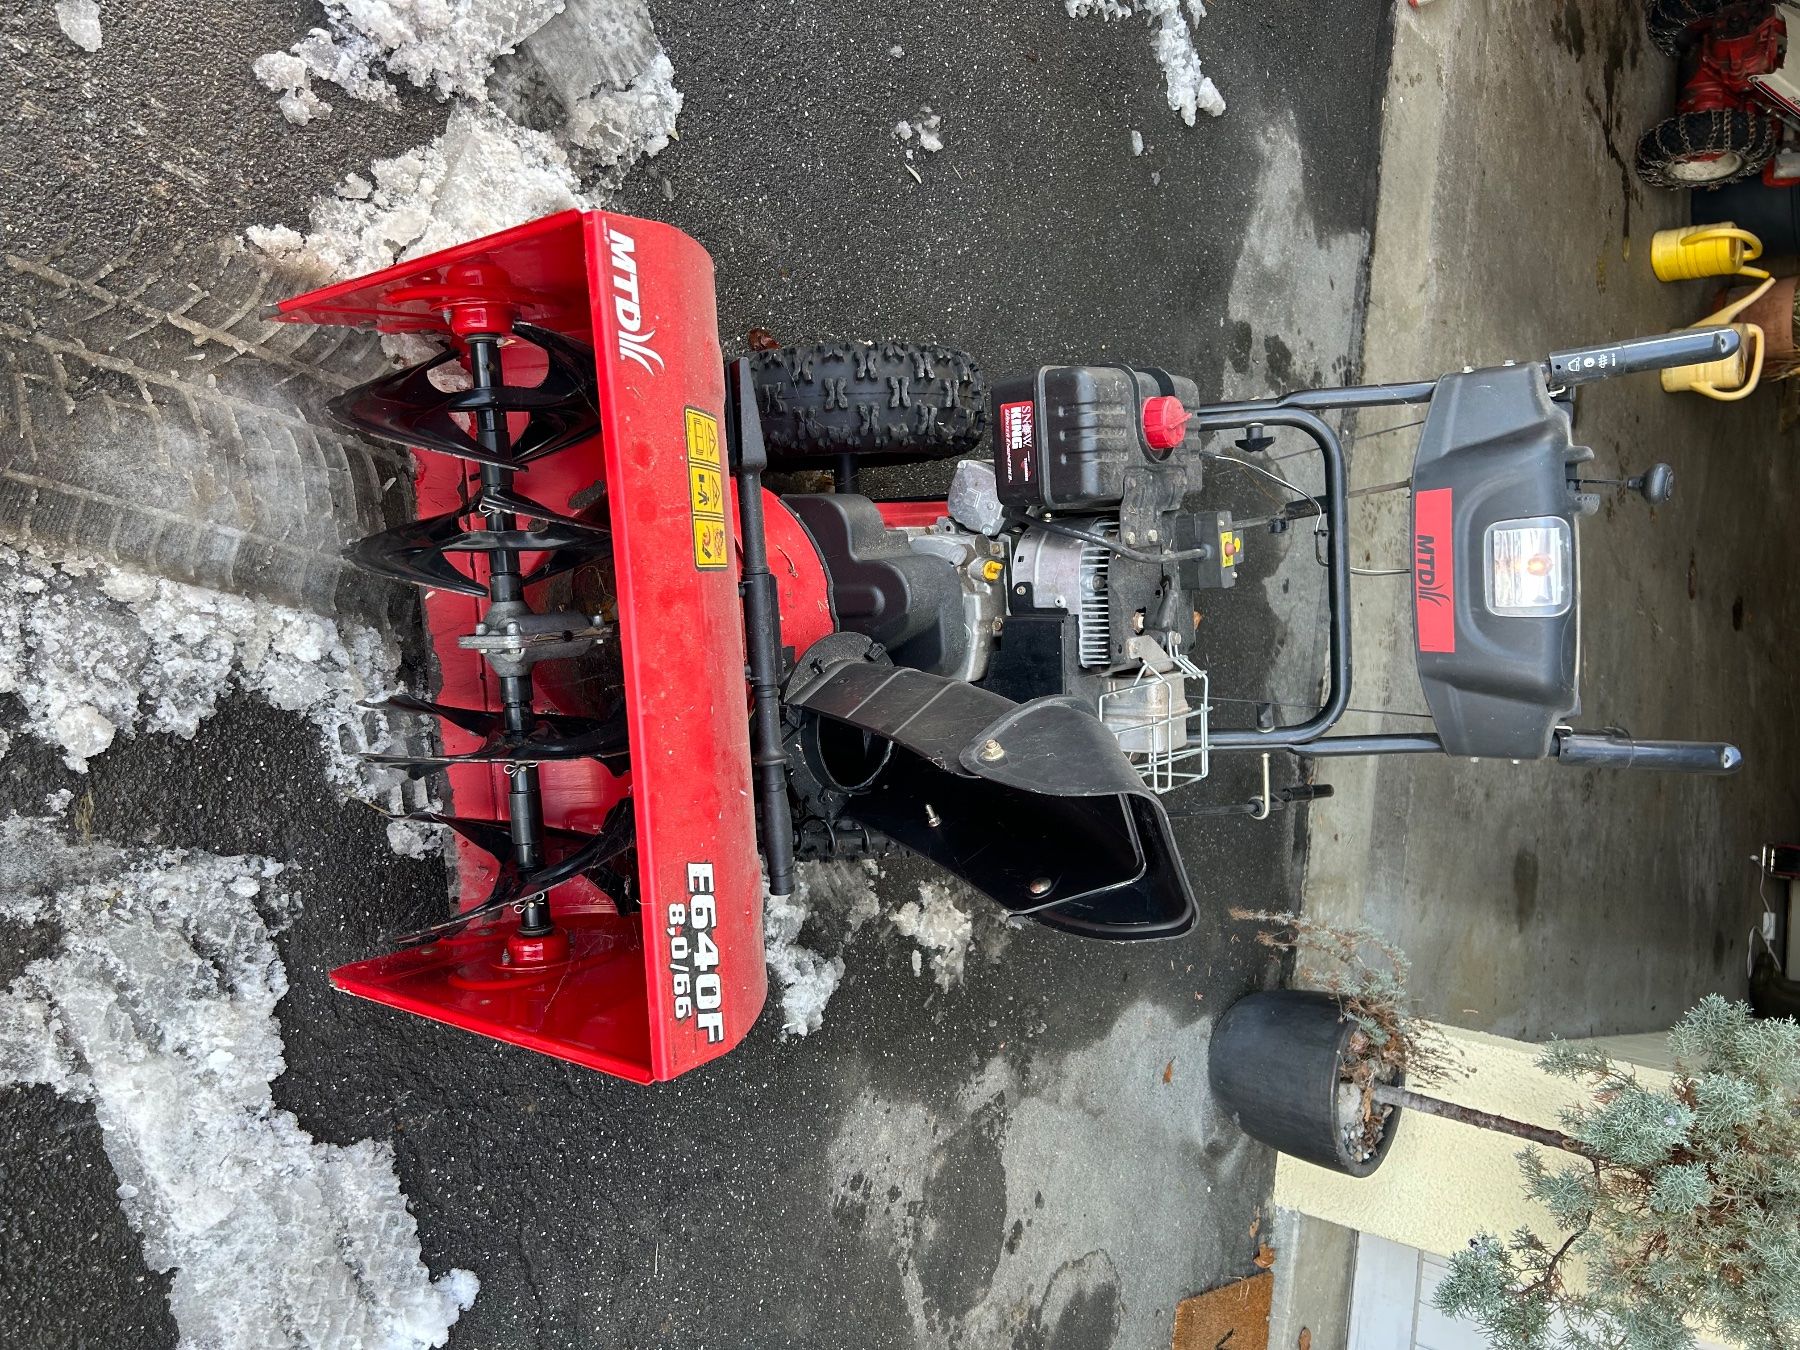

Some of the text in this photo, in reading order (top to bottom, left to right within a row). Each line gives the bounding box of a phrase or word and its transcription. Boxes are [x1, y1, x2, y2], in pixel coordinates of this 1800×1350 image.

[609, 229, 641, 331] MTD
[1011, 407, 1023, 449] KING
[1417, 535, 1435, 585] MTD
[666, 903, 692, 1019] 8,0/66
[687, 862, 724, 1043] E640F
